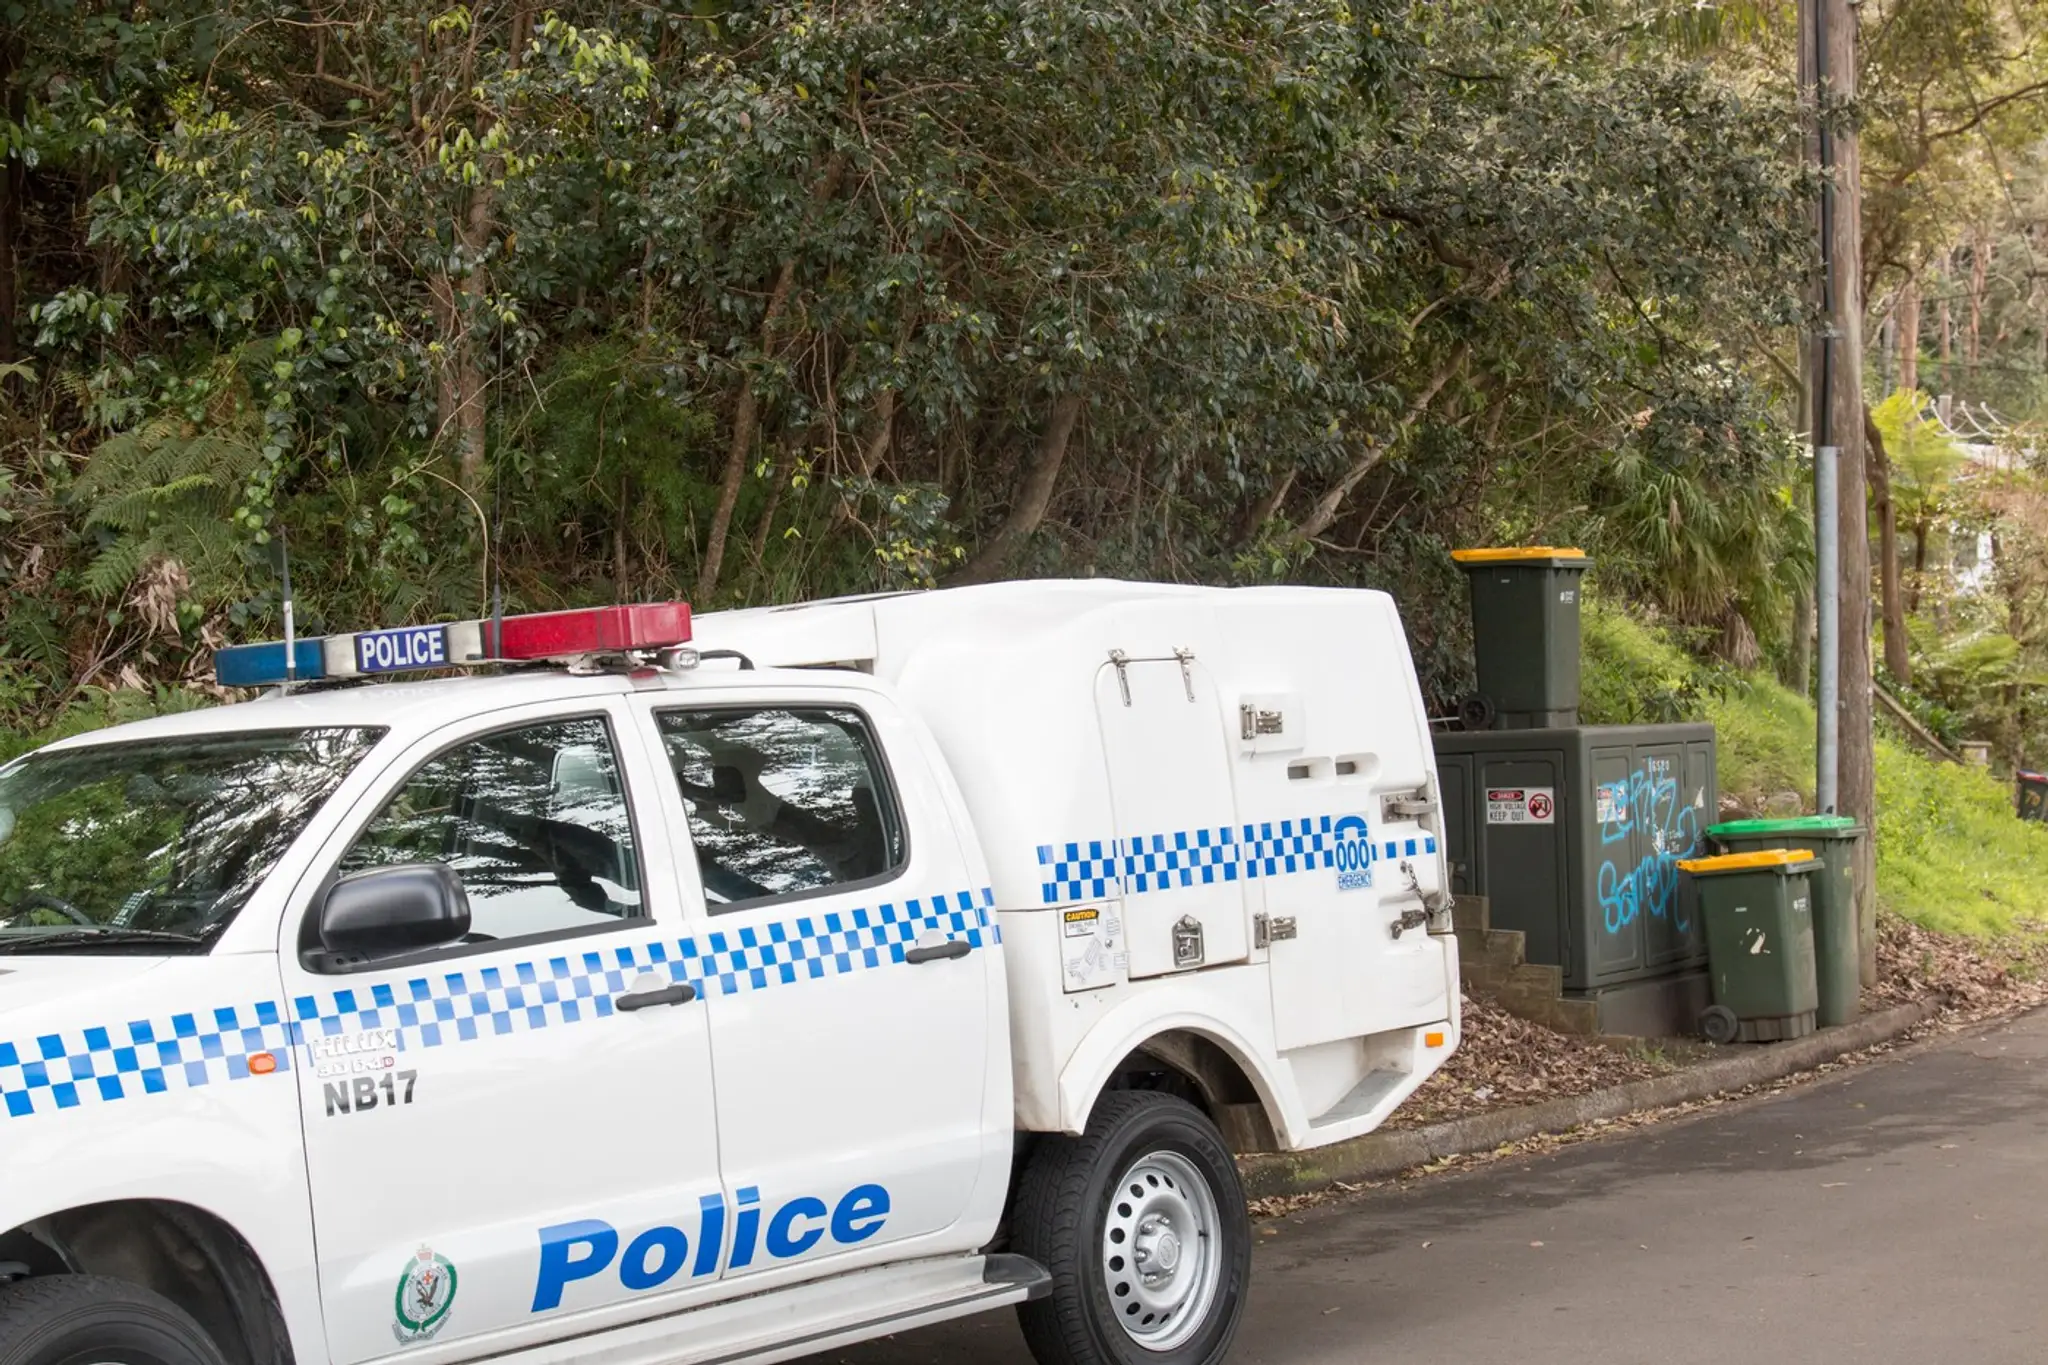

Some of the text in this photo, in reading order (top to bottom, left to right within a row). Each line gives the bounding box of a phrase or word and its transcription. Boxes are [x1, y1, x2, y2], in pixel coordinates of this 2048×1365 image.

[361, 630, 444, 669] POLICE
[1489, 802, 1527, 810] HIGH VOLTAGE
[1489, 810, 1525, 821] KEEP OUT
[1336, 838, 1370, 872] 000
[1066, 910, 1097, 921] CAUTION
[323, 1069, 418, 1117] NB17
[531, 1183, 890, 1312] Police
